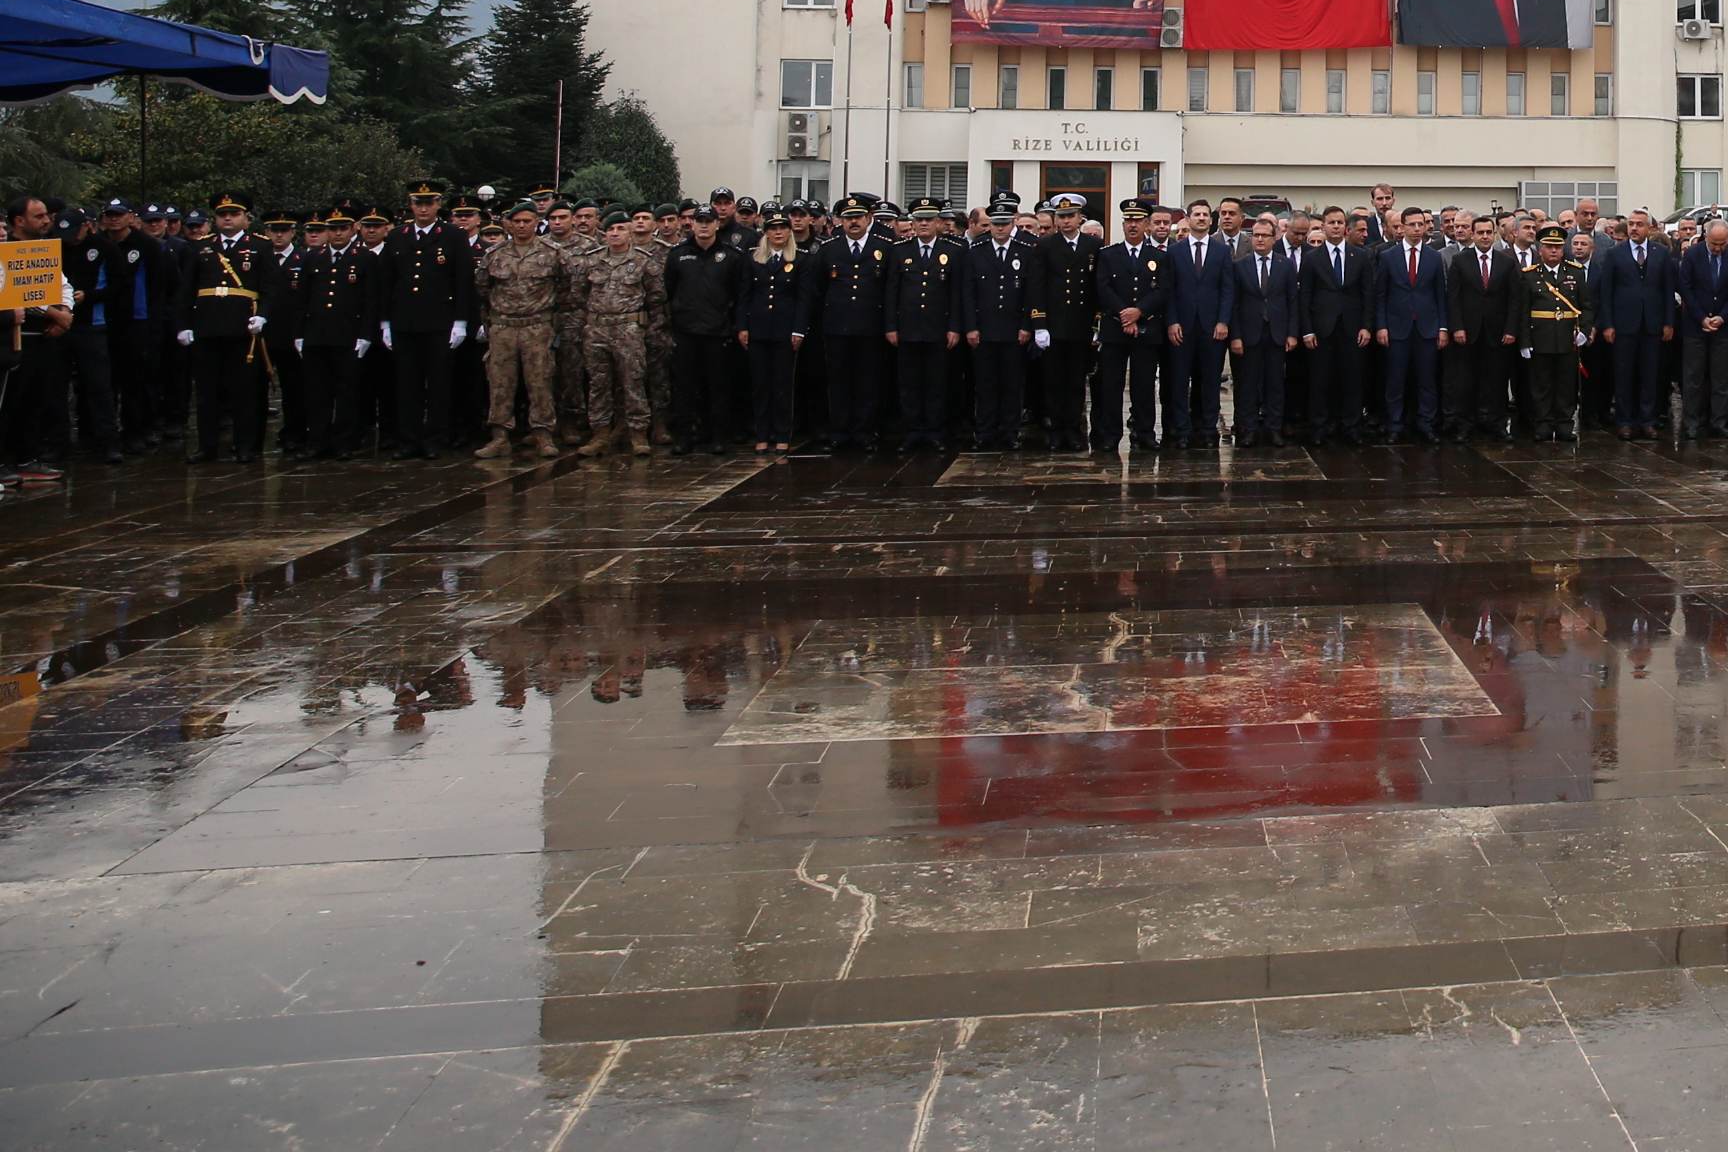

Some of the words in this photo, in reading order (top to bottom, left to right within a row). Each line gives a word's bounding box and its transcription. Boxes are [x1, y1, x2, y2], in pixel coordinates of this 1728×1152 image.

[1061, 123, 1089, 134] T.C.
[1012, 136, 1052, 150] RİZE
[1062, 137, 1140, 151] VALİLİĞİ
[26, 257, 58, 269] ANADOLU
